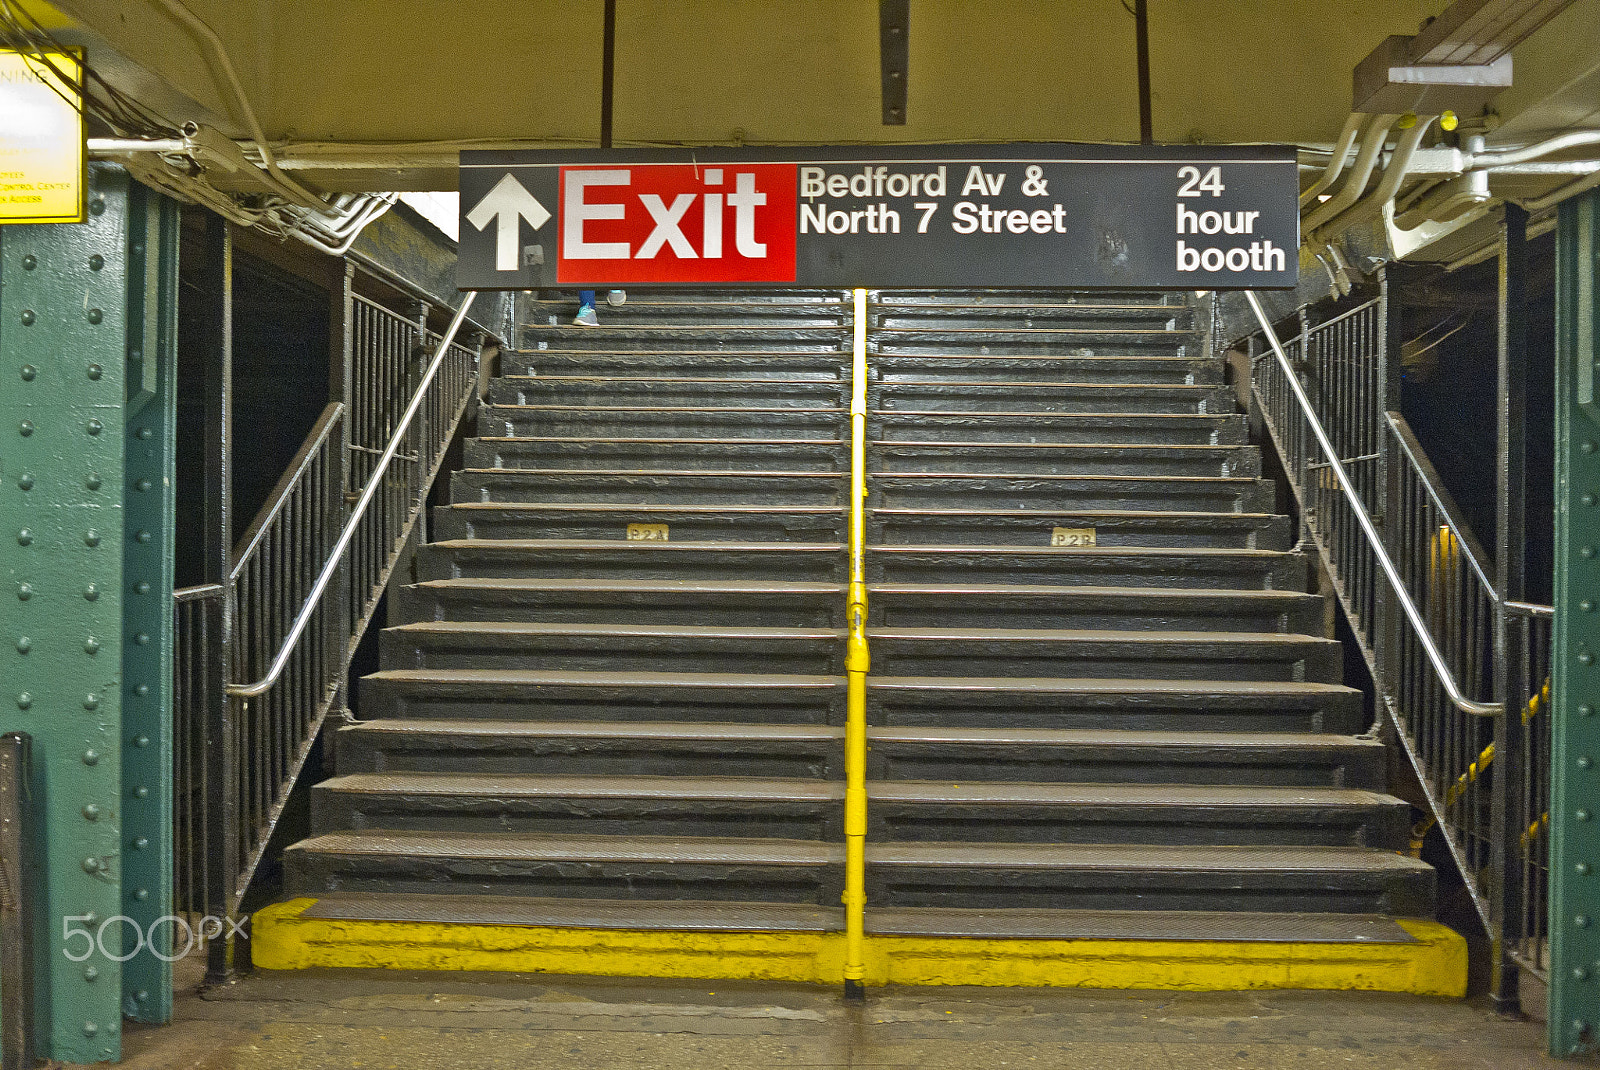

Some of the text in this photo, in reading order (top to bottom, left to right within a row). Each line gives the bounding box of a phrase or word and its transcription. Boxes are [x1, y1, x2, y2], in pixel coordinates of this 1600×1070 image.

[800, 164, 1049, 198] Bedford Av &
[1176, 165, 1226, 197] 24
[562, 168, 767, 260] Exit
[800, 201, 1067, 235] North 7 Street
[1176, 202, 1260, 235] hour
[1176, 240, 1286, 272] booth
